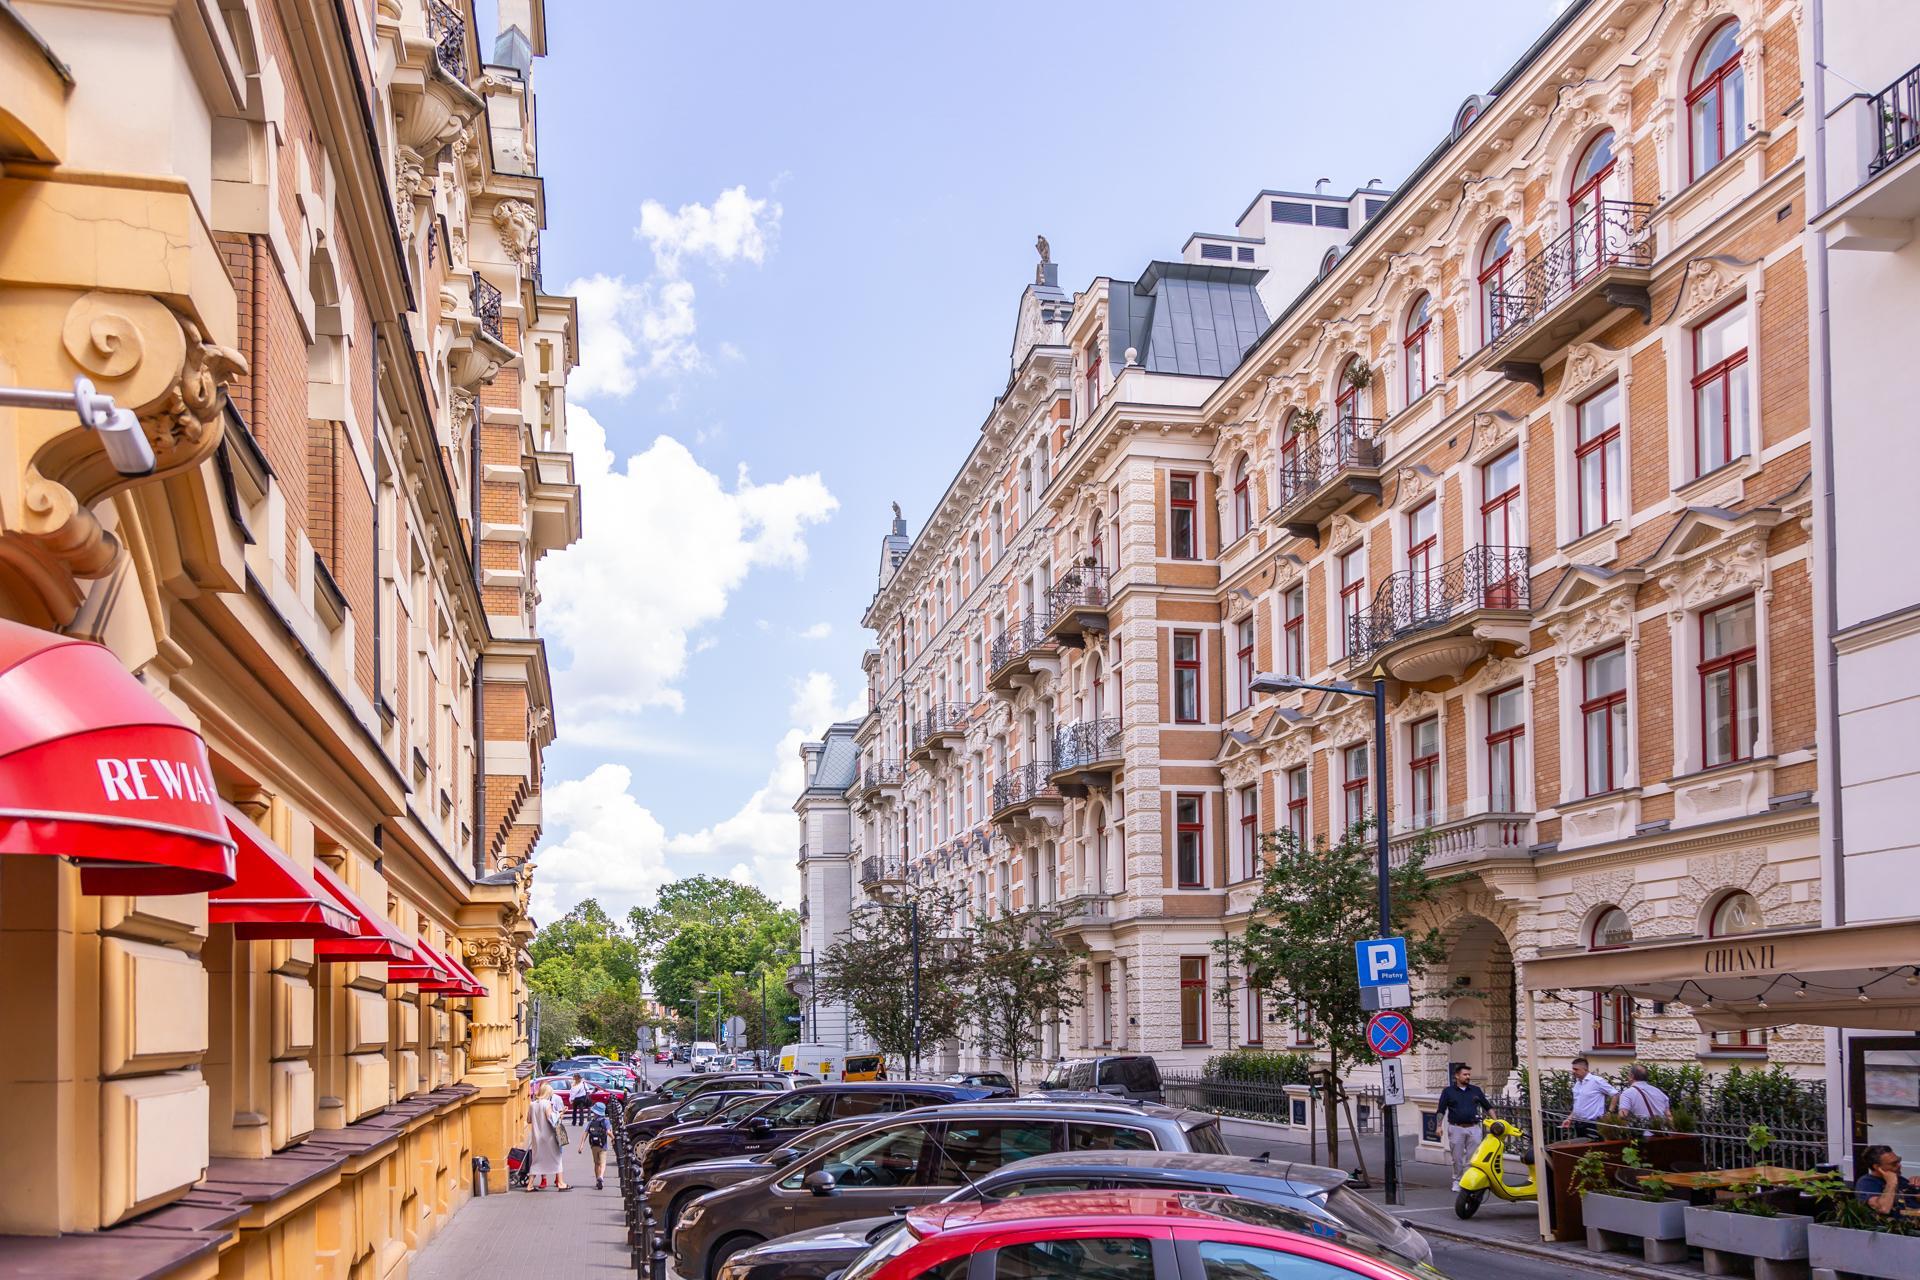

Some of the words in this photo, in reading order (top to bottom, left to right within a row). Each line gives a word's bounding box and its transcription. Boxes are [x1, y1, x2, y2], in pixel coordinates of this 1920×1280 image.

[97, 758, 212, 805] REWIA
[1368, 944, 1396, 980] P
[1705, 945, 1774, 973] CHIANTI
